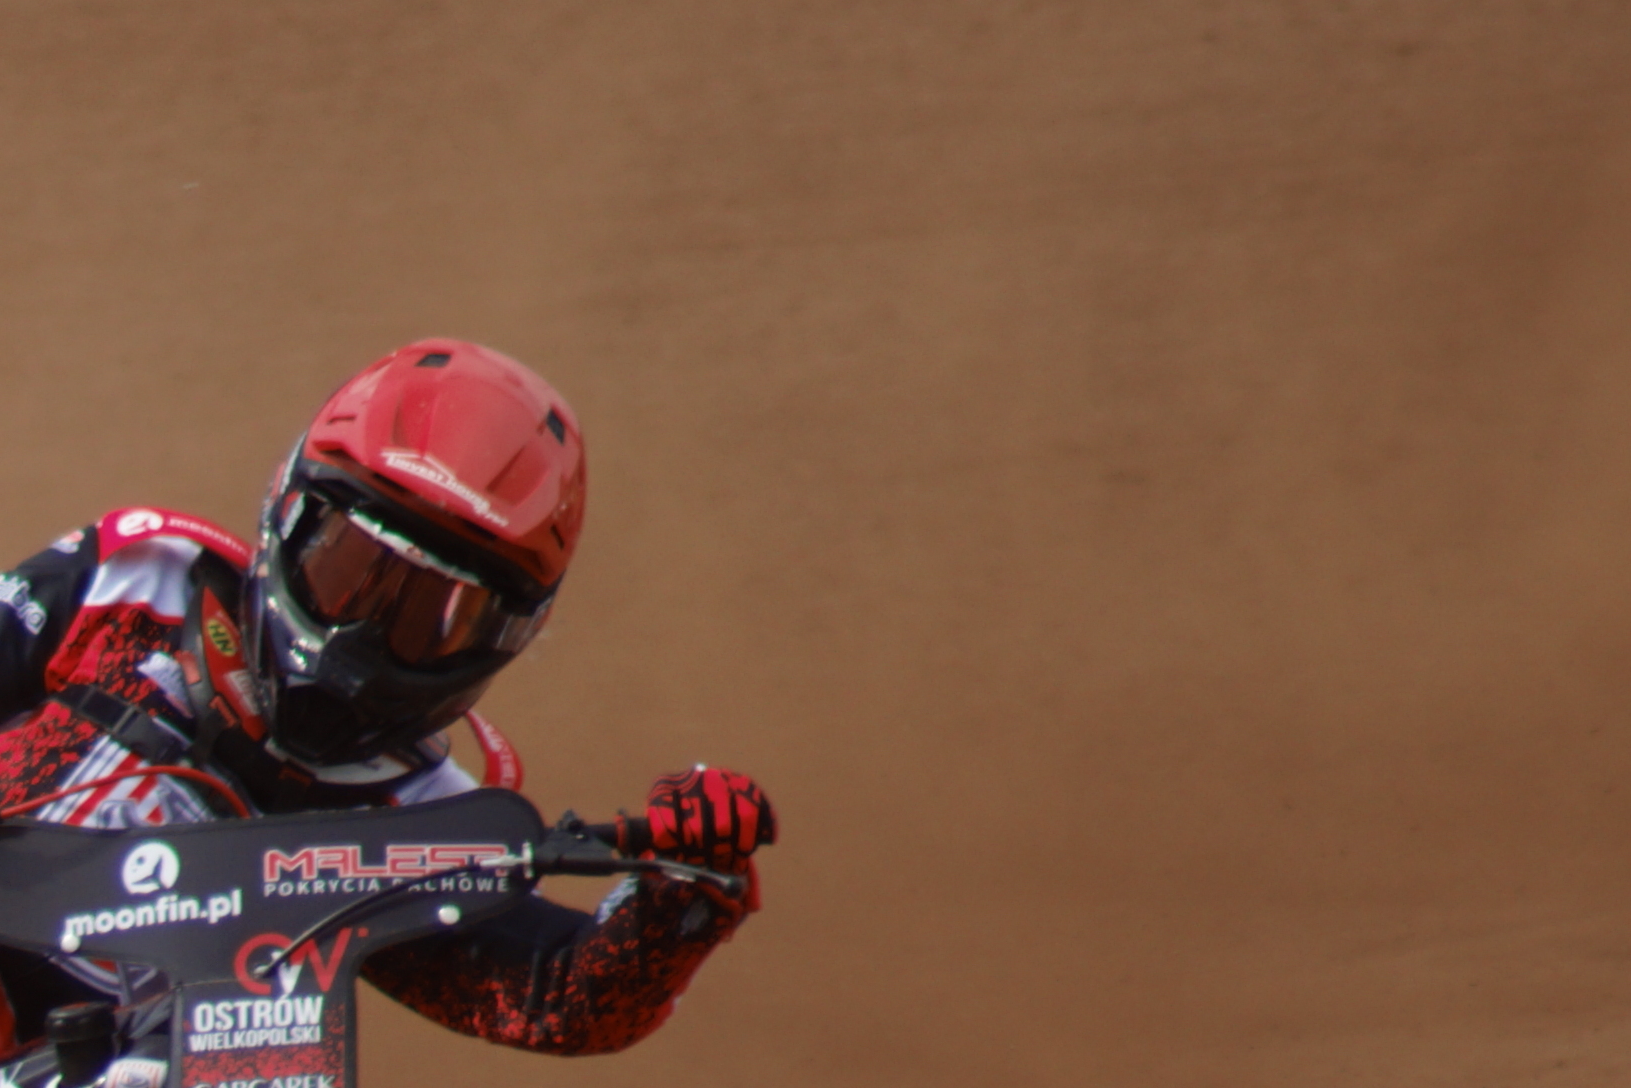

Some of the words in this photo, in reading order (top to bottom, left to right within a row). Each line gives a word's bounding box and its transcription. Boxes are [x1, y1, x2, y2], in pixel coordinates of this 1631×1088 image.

[263, 876, 382, 898] POKRYCIA
[63, 888, 243, 938] moonfin.pl
[193, 994, 324, 1034] OSTRÓW
[188, 1025, 321, 1053] WIELKOPOLSKI
